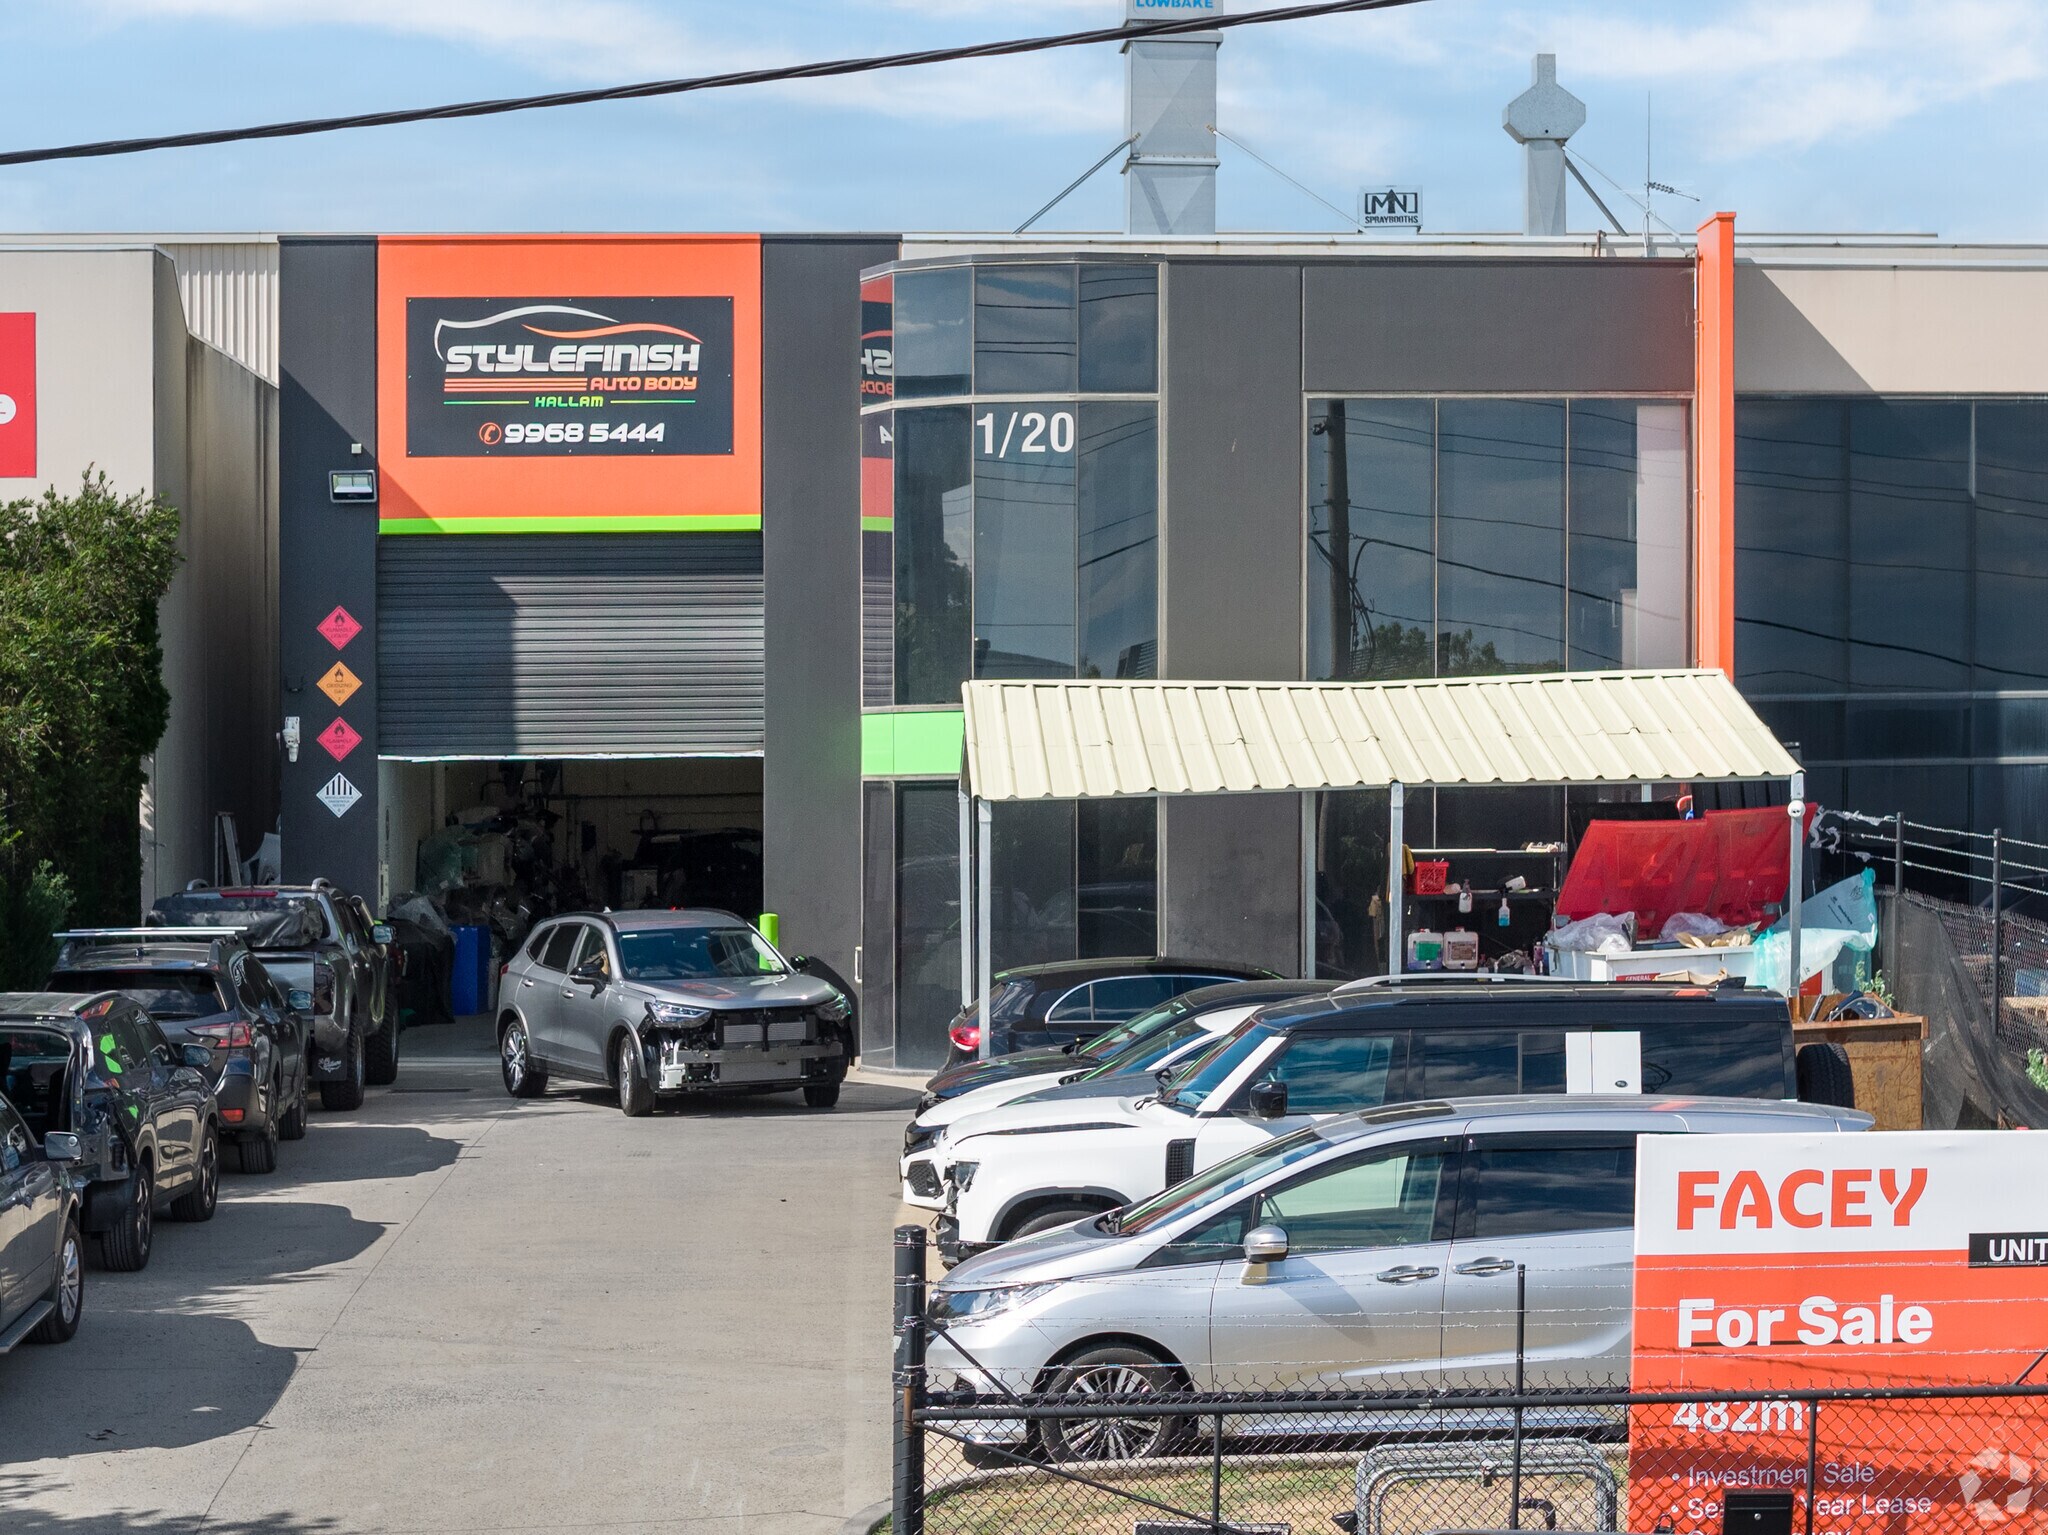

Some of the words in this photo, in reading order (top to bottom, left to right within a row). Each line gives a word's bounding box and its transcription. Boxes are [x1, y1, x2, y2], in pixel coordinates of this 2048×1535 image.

[1365, 215, 1418, 224] SPRAYBOOTHS
[445, 344, 700, 372] STYLEFINISH
[590, 377, 641, 391] AUTO
[644, 376, 697, 391] BODY
[534, 396, 604, 408] HALLAM
[504, 422, 584, 444] 9968
[589, 422, 665, 443] 5444
[976, 411, 1075, 458] 1/20
[1677, 1168, 1928, 1230] FACEY
[1989, 1238, 2048, 1262] UNIT
[1678, 1298, 1784, 1348] For
[1797, 1294, 1933, 1346] Sale
[1688, 1464, 1808, 1487] Investmen
[1823, 1462, 1874, 1484] Sale
[1861, 1493, 1932, 1515] Lease
